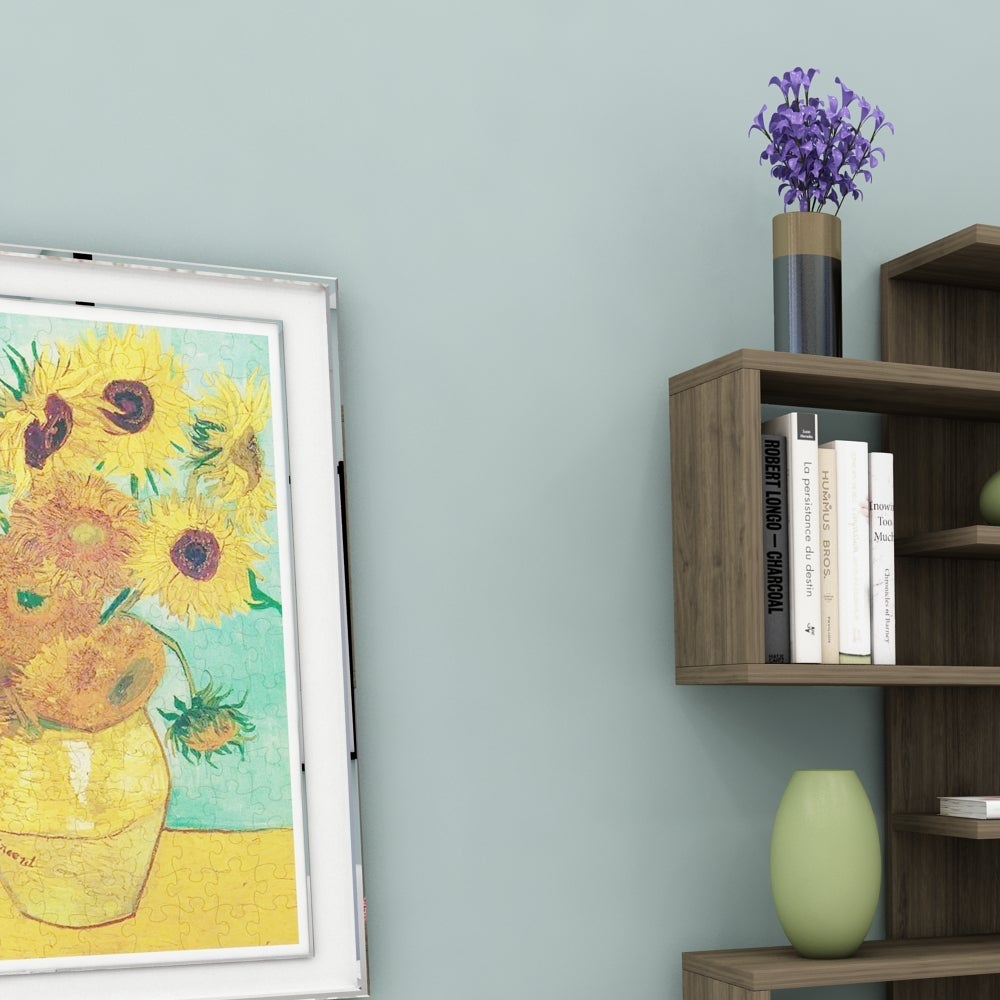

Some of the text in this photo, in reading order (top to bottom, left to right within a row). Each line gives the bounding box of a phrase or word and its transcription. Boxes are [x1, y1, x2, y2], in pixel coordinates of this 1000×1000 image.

[765, 440, 781, 488] ROBERT
[766, 491, 782, 530] LONGO
[822, 471, 832, 531] HUMMUS
[878, 517, 892, 526] Too
[802, 462, 814, 597] La persistance du destin
[767, 551, 783, 615] CHARCOAL
[0, 841, 36, 868] ncent
